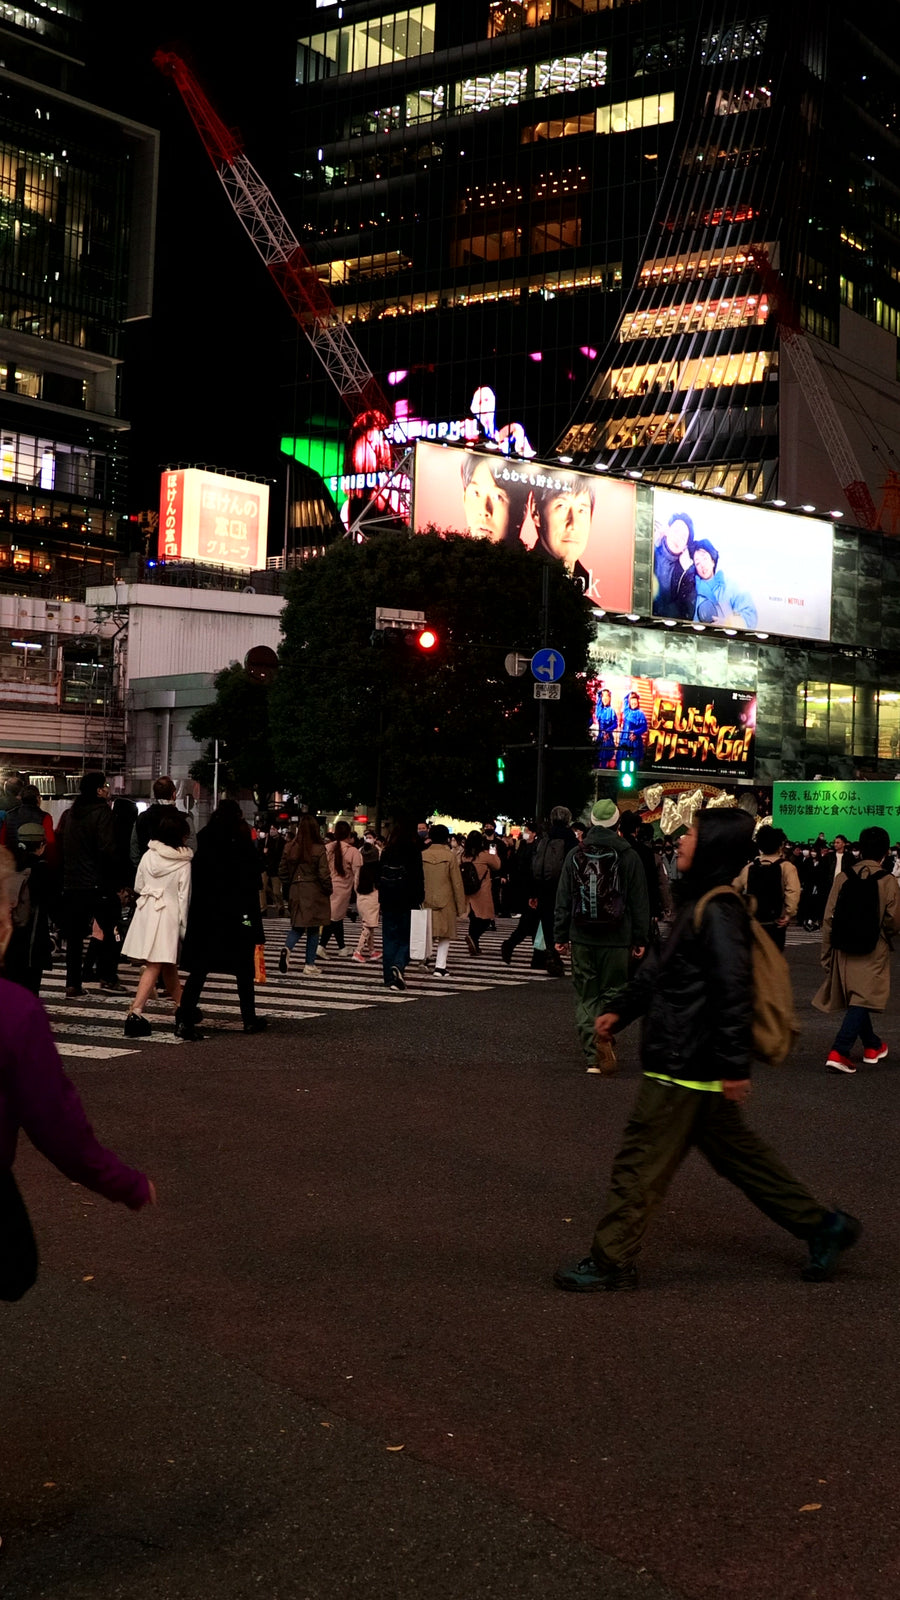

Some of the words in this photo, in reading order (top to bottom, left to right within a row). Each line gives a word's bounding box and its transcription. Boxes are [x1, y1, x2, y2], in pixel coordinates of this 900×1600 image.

[165, 474, 178, 556] ほけんの窓口
[202, 490, 258, 519] ほけんの
[206, 540, 251, 560] グループ
[787, 597, 805, 607] NETFLIX
[651, 697, 720, 737] にしたん
[779, 789, 862, 802] 今夜、私が頂くのは、
